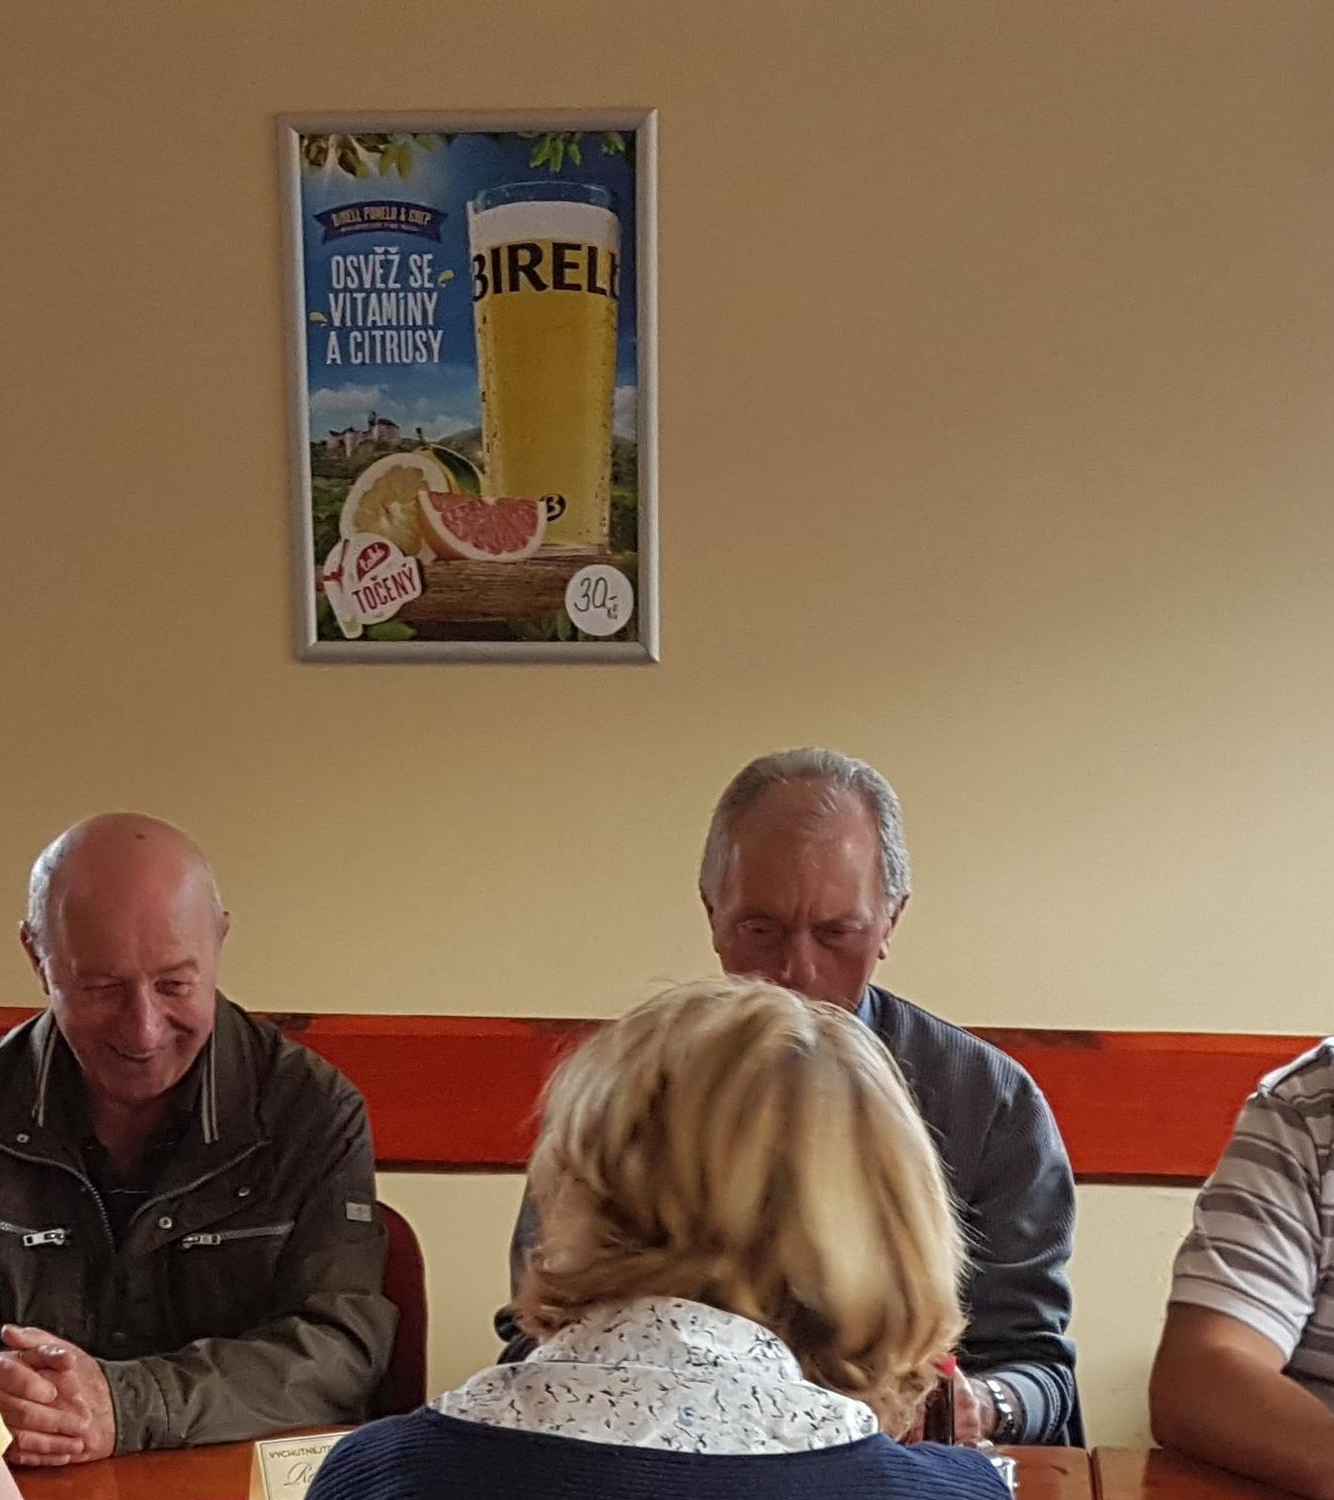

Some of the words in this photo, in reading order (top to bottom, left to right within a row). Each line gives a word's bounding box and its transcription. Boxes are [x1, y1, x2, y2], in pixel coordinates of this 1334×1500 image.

[331, 246, 401, 289] OSVĚŽ
[409, 253, 435, 289] SE
[329, 291, 438, 327] VITAMÍNY
[325, 330, 343, 366] A
[349, 329, 444, 364] CITRUSY
[351, 562, 417, 615] TOČENÝ
